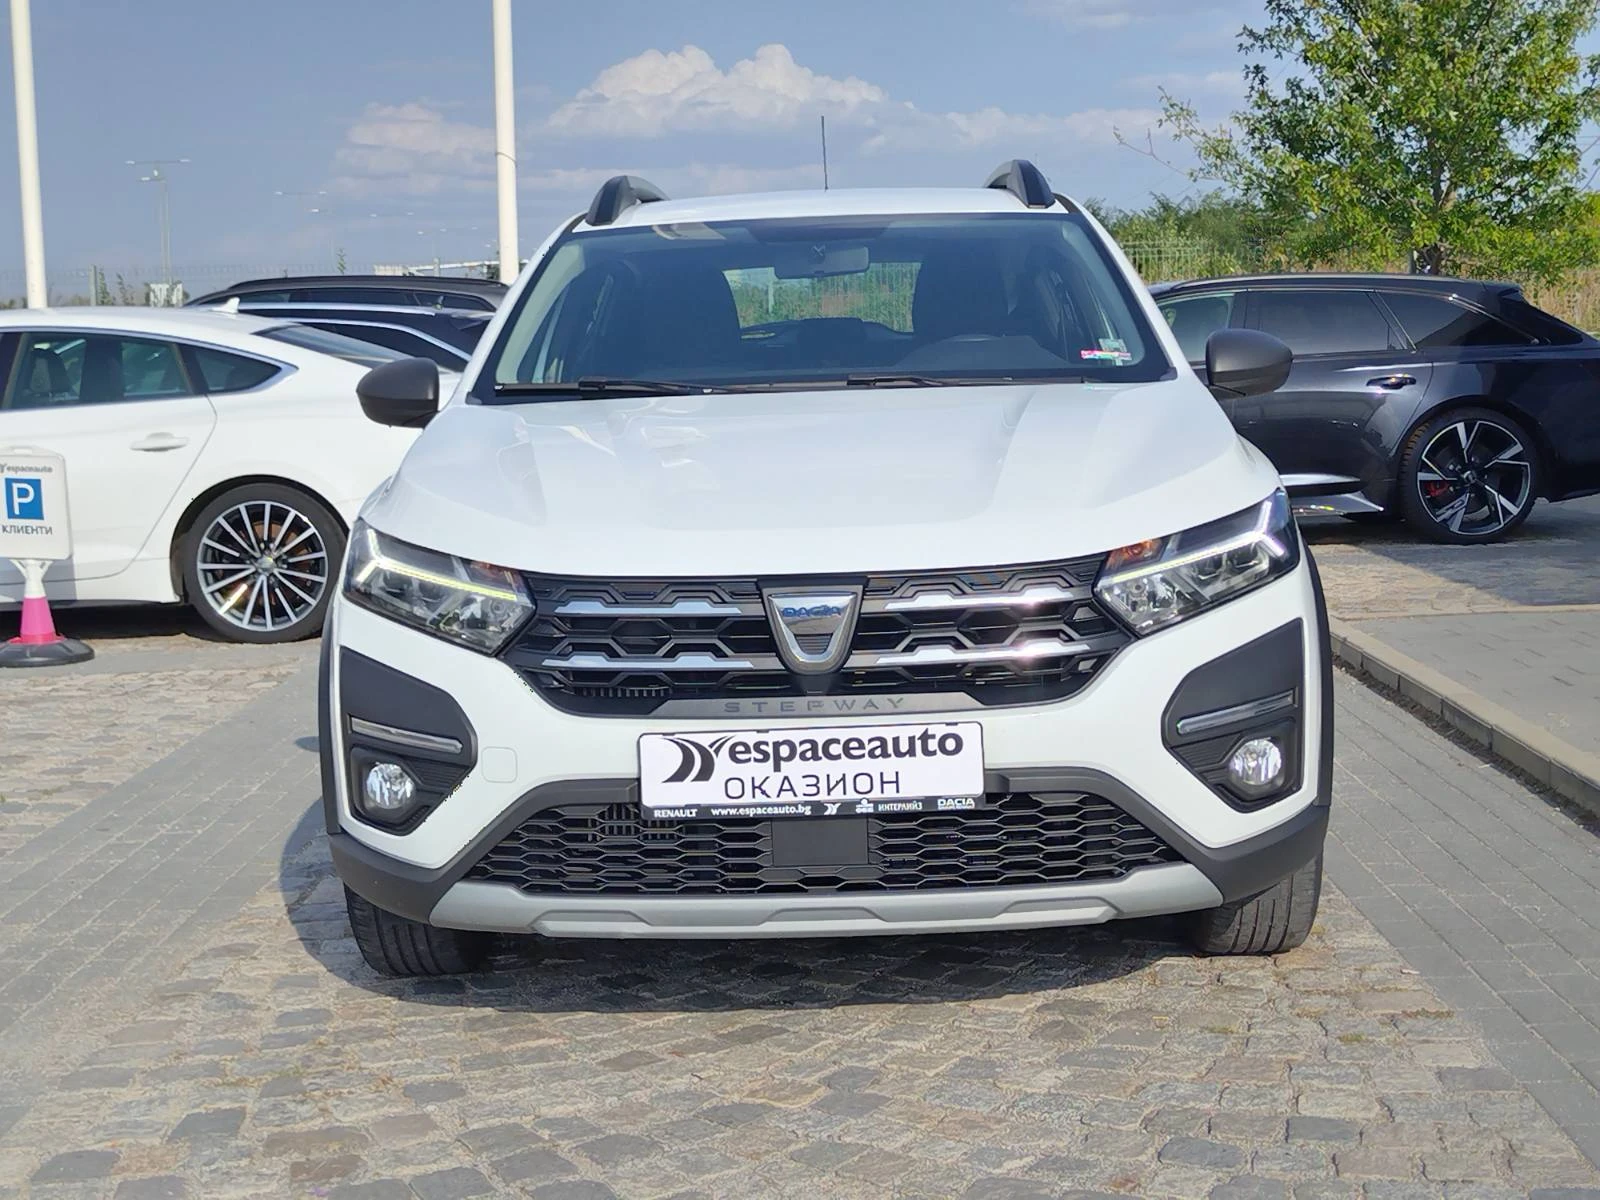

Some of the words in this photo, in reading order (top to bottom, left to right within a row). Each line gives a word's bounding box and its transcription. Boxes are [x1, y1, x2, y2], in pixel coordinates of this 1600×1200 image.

[11, 482, 35, 515] P
[1, 525, 53, 535] КЛИЕНТИ
[724, 697, 905, 714] STEPWAY
[728, 727, 965, 772] espaceauto
[724, 770, 901, 800] ОКАЗИОН
[937, 797, 976, 808] DACIA
[653, 808, 699, 819] RENAULT
[710, 804, 812, 817] www.espaceauto.bg
